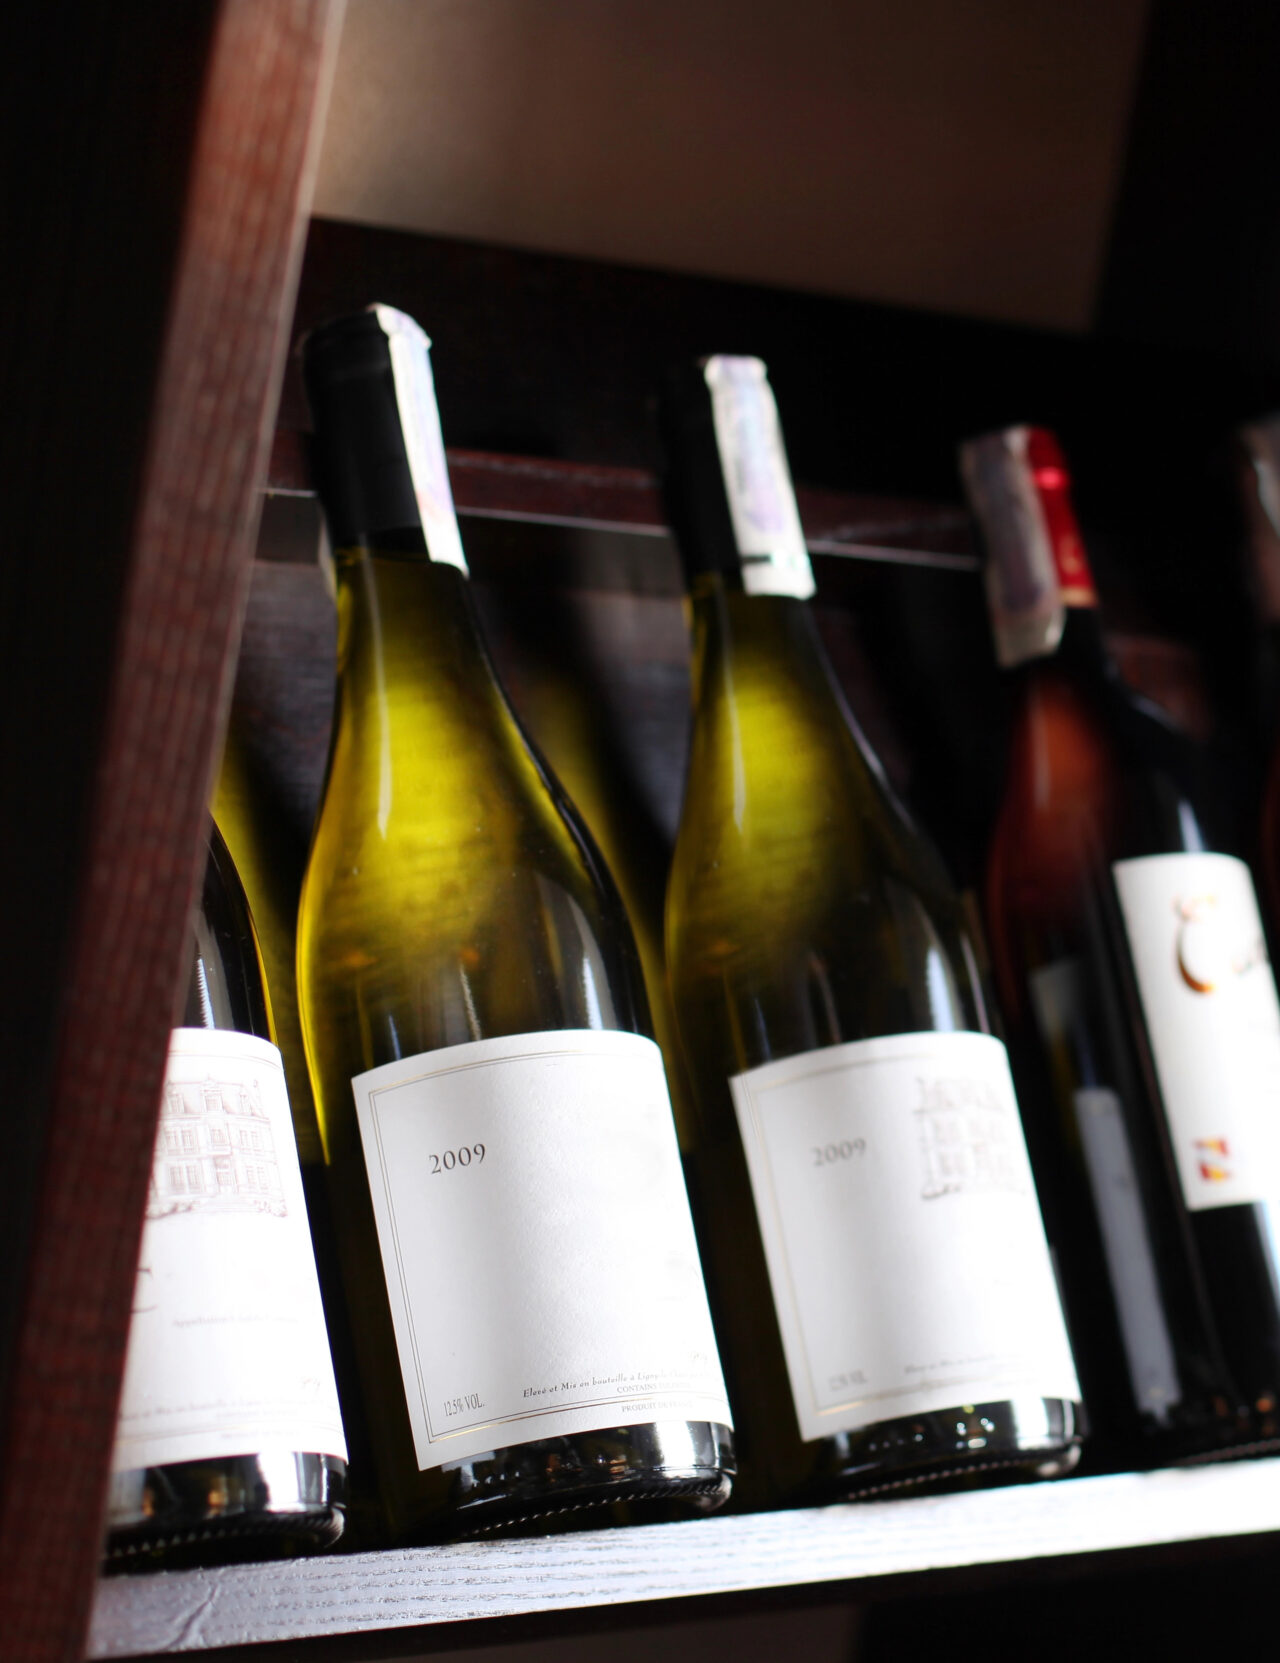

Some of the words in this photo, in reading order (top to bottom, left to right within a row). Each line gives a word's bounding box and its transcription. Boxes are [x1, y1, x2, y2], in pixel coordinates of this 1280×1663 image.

[429, 1143, 486, 1175] 2009
[810, 1136, 867, 1167] 2009
[549, 1385, 558, 1393] et
[561, 1382, 576, 1391] Mis
[592, 1373, 628, 1385] bouteille
[616, 1382, 658, 1393] CONTAINS
[464, 1393, 485, 1410] VOL.
[622, 1402, 656, 1413] PRODUIT
